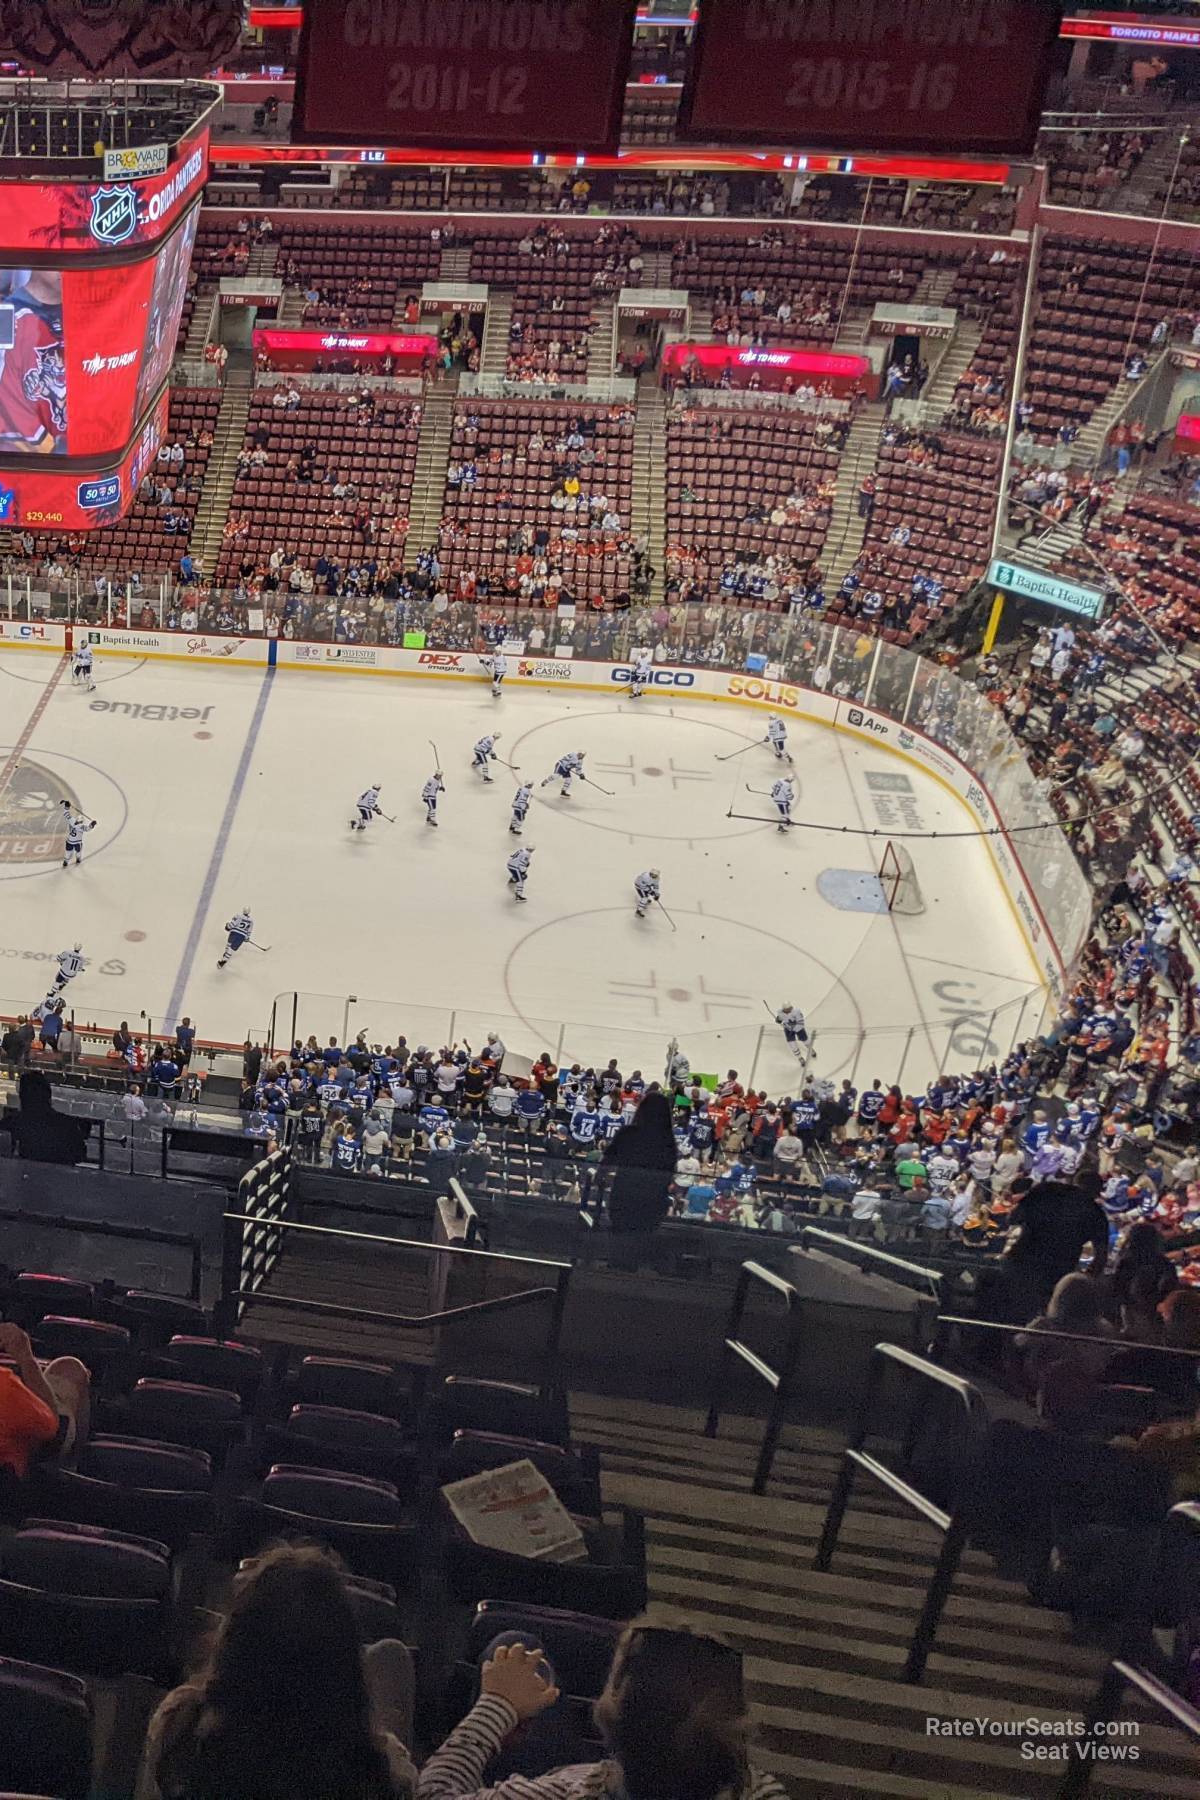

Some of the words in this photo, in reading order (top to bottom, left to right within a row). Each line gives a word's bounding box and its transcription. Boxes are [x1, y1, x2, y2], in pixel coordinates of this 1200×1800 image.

[1110, 26, 1161, 39] TORONTO
[1163, 30, 1199, 42] MAPLE
[101, 200, 129, 232] NHL
[85, 490, 98, 499] 50
[107, 485, 117, 495] 50
[26, 512, 63, 522] $29,440
[1016, 574, 1054, 595] Baptist
[1057, 587, 1098, 609] Health
[20, 626, 44, 637] CH
[103, 635, 131, 646] Baptist
[132, 638, 159, 647] Health
[418, 653, 462, 667] DEX
[427, 665, 465, 673] imaging
[534, 667, 572, 677] CASINO
[611, 668, 695, 686] GICO
[728, 676, 800, 708] SOLIS
[89, 700, 216, 724] jetBlue
[862, 717, 889, 735] App
[71, 959, 80, 971] 11
[323, 1088, 337, 1100] 34
[580, 1122, 593, 1136] 14
[338, 1150, 354, 1163] 34
